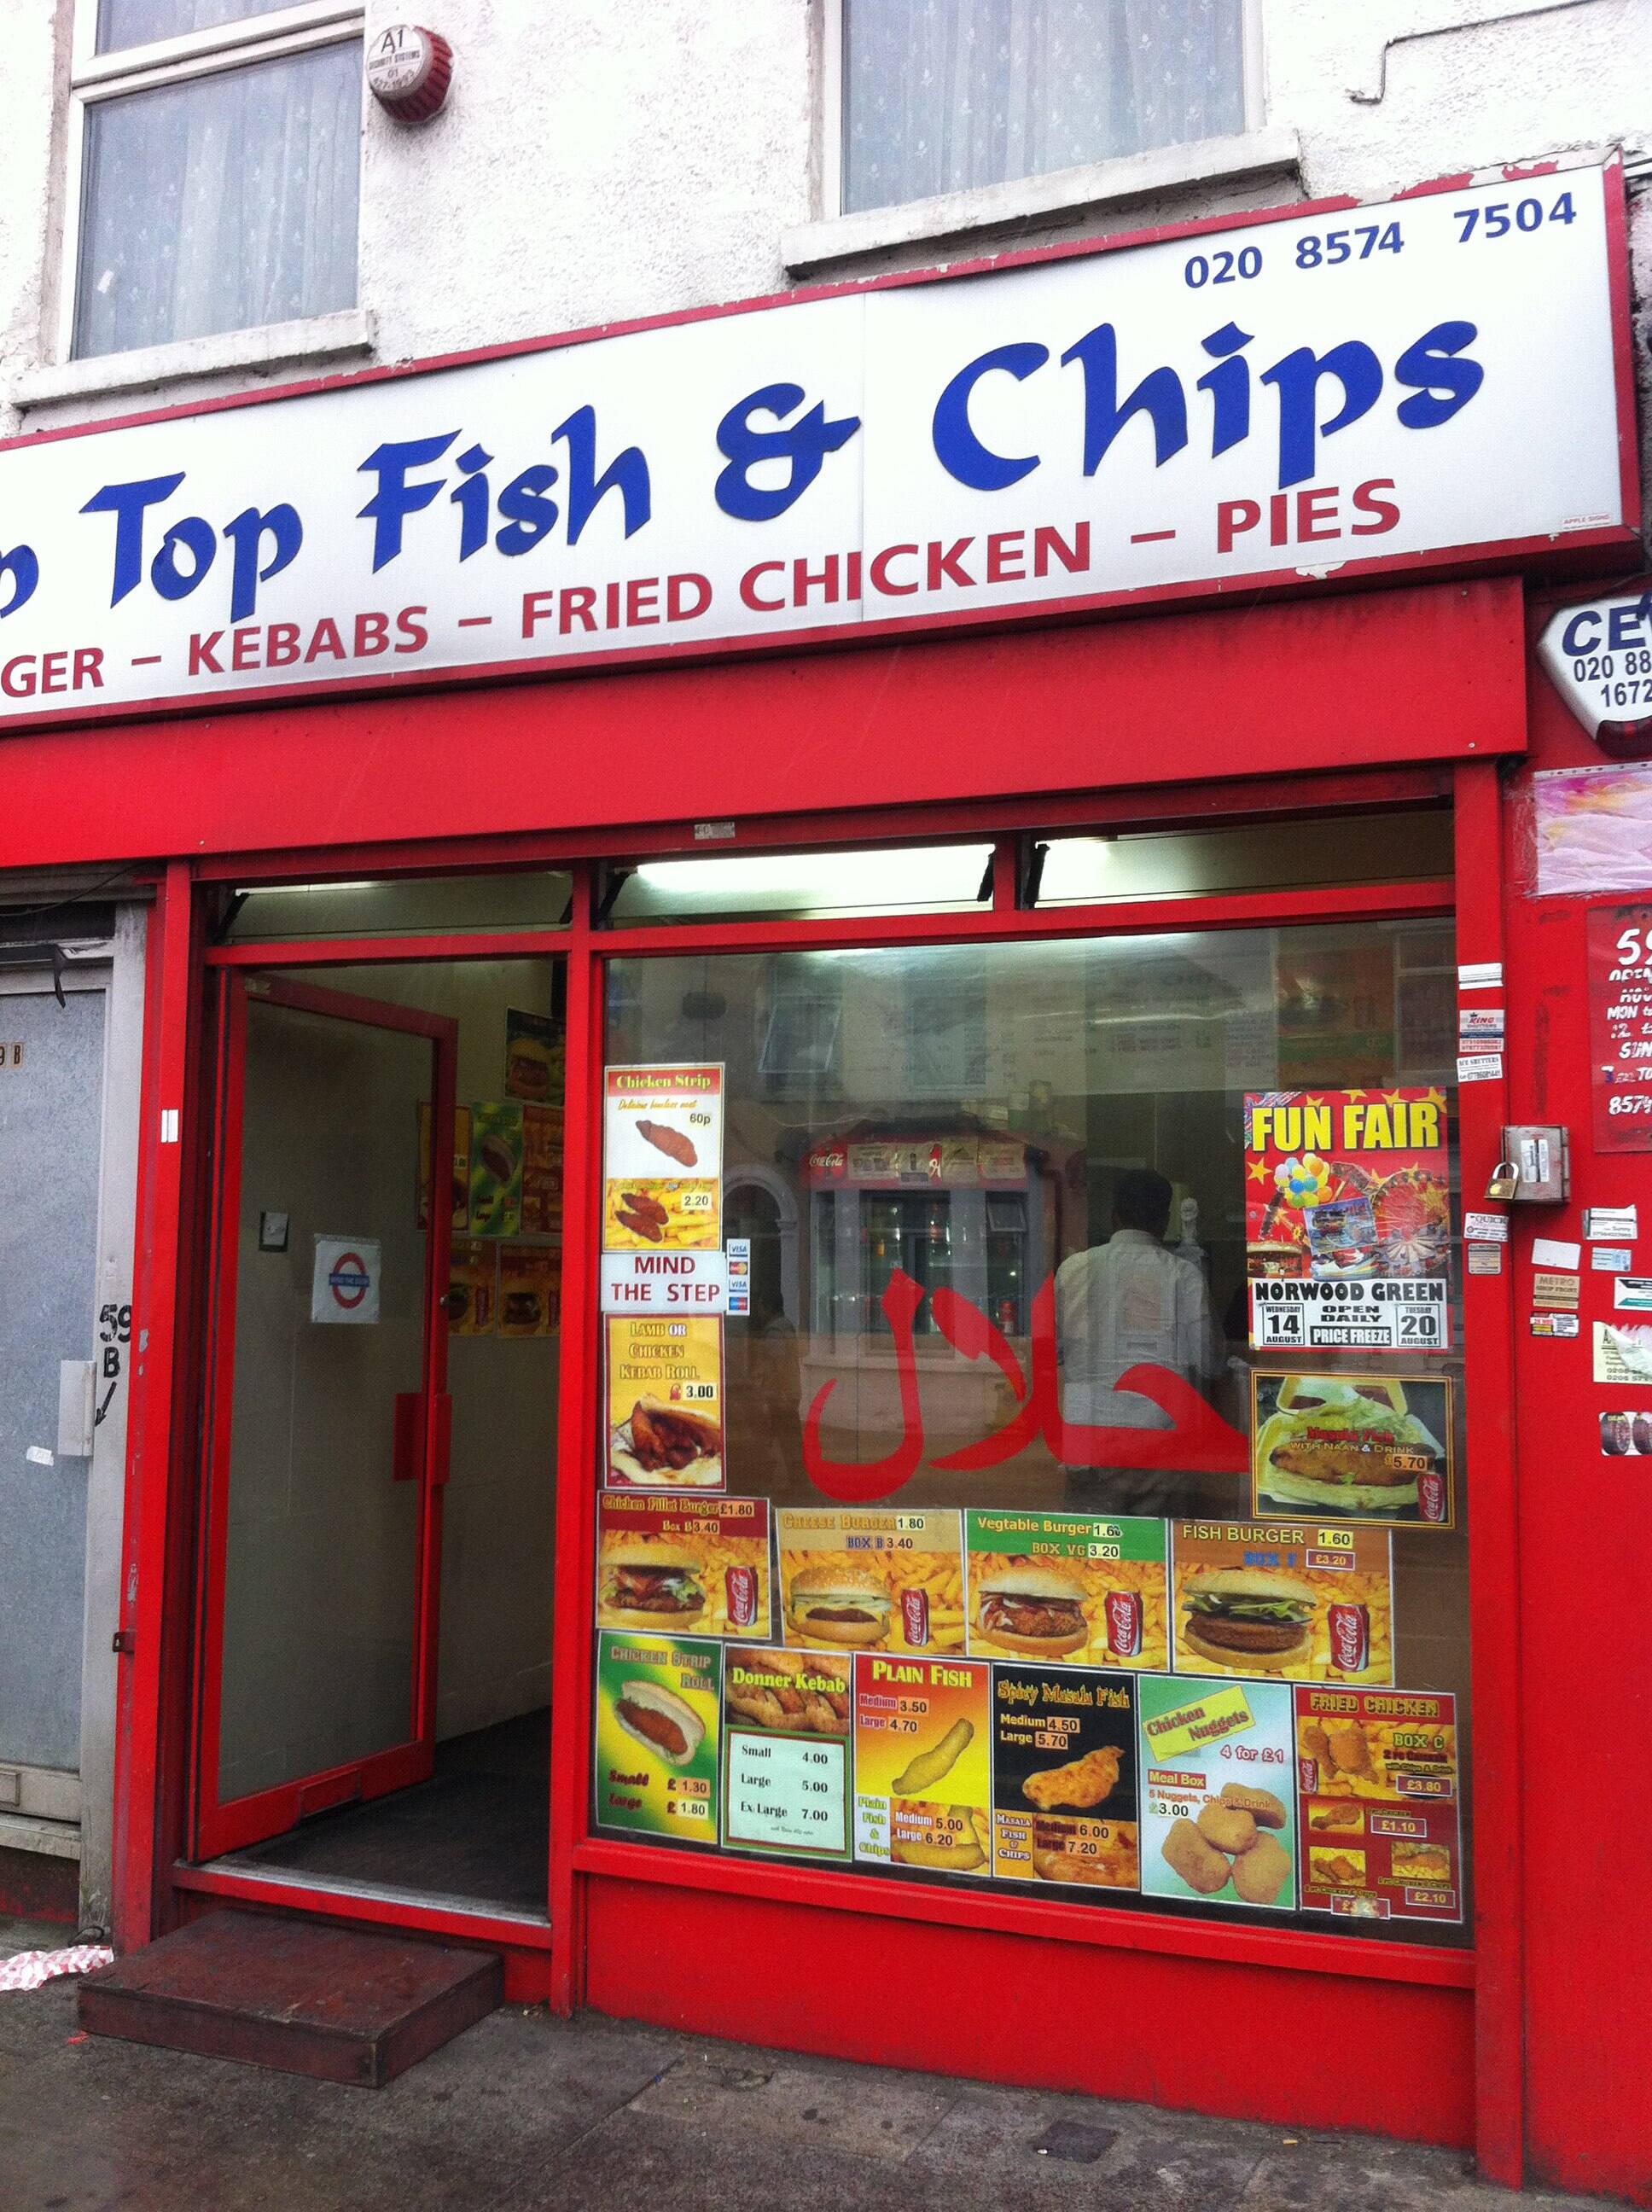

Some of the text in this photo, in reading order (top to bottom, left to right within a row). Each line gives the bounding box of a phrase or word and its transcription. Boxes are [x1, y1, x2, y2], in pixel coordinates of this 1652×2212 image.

[381, 28, 403, 54] A1
[1184, 192, 1577, 288] 020 8574 7504
[79, 320, 1484, 623] Top Fish & Chips
[0, 479, 1400, 698] GER KEBABS FRIED CHICKEN PIES
[1573, 655, 1614, 683] 020
[616, 1074, 711, 1091] Chicken Strip
[690, 1114, 712, 1126] 60p
[1252, 1102, 1440, 1151] FUN FAIR
[684, 1196, 708, 1206] 2.20
[634, 1256, 695, 1274] MIND
[611, 1284, 721, 1302] THE STEP
[1255, 1283, 1443, 1301] NORWOOD GREEN
[1322, 1305, 1380, 1313] OPEN
[99, 1304, 132, 1343] 59
[1267, 1314, 1300, 1334] 14
[1320, 1314, 1382, 1323] DAILY
[1400, 1315, 1436, 1336] 20
[1265, 1336, 1302, 1344] AUGUST
[1313, 1328, 1390, 1345] PRICE FREEZE
[1400, 1337, 1439, 1346] AUGUST
[629, 1343, 684, 1359] CHICKEN
[103, 1347, 120, 1378] B
[620, 1365, 699, 1380] KEBAB ROLL
[687, 1385, 713, 1398] 3.00
[802, 1266, 1250, 1503] حلال
[1323, 1442, 1360, 1452] NAAN
[1361, 1444, 1371, 1452] &
[1374, 1445, 1414, 1454] DRINK
[602, 1495, 645, 1511] Chicken
[680, 1499, 718, 1516] Burger
[720, 1505, 753, 1515] £1.80
[663, 1520, 680, 1531] Box
[695, 1522, 718, 1533] 3.40
[898, 1518, 924, 1529] 1.80
[978, 1517, 1092, 1535] Vegtable Burger
[846, 1536, 870, 1549] BOX
[887, 1538, 913, 1549] 3.40
[1183, 1525, 1351, 1545] FISH BURGER 1.60
[1032, 1543, 1119, 1557] BOX VG 3.20
[1316, 1554, 1347, 1567] £3.20
[732, 1667, 846, 1694] Donner Kebab
[872, 1660, 973, 1688] PLAIN FISH
[998, 1679, 1131, 1708] Spicy Masala Fish
[859, 1694, 928, 1714] Medium 3.50
[1311, 1693, 1440, 1717] FRIED CHICKEN
[860, 1714, 917, 1733] Large 4.70
[1000, 1714, 1078, 1732] Medium 4.50
[1147, 1706, 1206, 1737] Chicken
[1188, 1709, 1249, 1742] Nuggets
[1000, 1730, 1067, 1748] Large 5.70
[1393, 1732, 1444, 1749] BOX C
[742, 1744, 828, 1765] Small 4.00
[1221, 1744, 1231, 1759] 4
[1236, 1745, 1258, 1761] for
[683, 1780, 707, 1794] 1.30
[741, 1773, 828, 1793] Large 5.00
[1149, 1771, 1205, 1786] Meal Box
[681, 1802, 706, 1816] 1.80
[757, 1802, 828, 1822] Large 7.00
[1245, 1798, 1271, 1808] Drink
[895, 1811, 963, 1831] Medium 5.00
[996, 1814, 1032, 1827] MASALA
[1381, 1819, 1416, 1833] £1.10
[897, 1828, 953, 1846] Large 6.20
[1001, 1829, 1027, 1840] FISH
[1079, 1825, 1109, 1838] 6.00
[998, 1848, 1031, 1860] CHIPS
[1068, 1841, 1097, 1854] 7.20
[1415, 1892, 1446, 1904] £2.10
